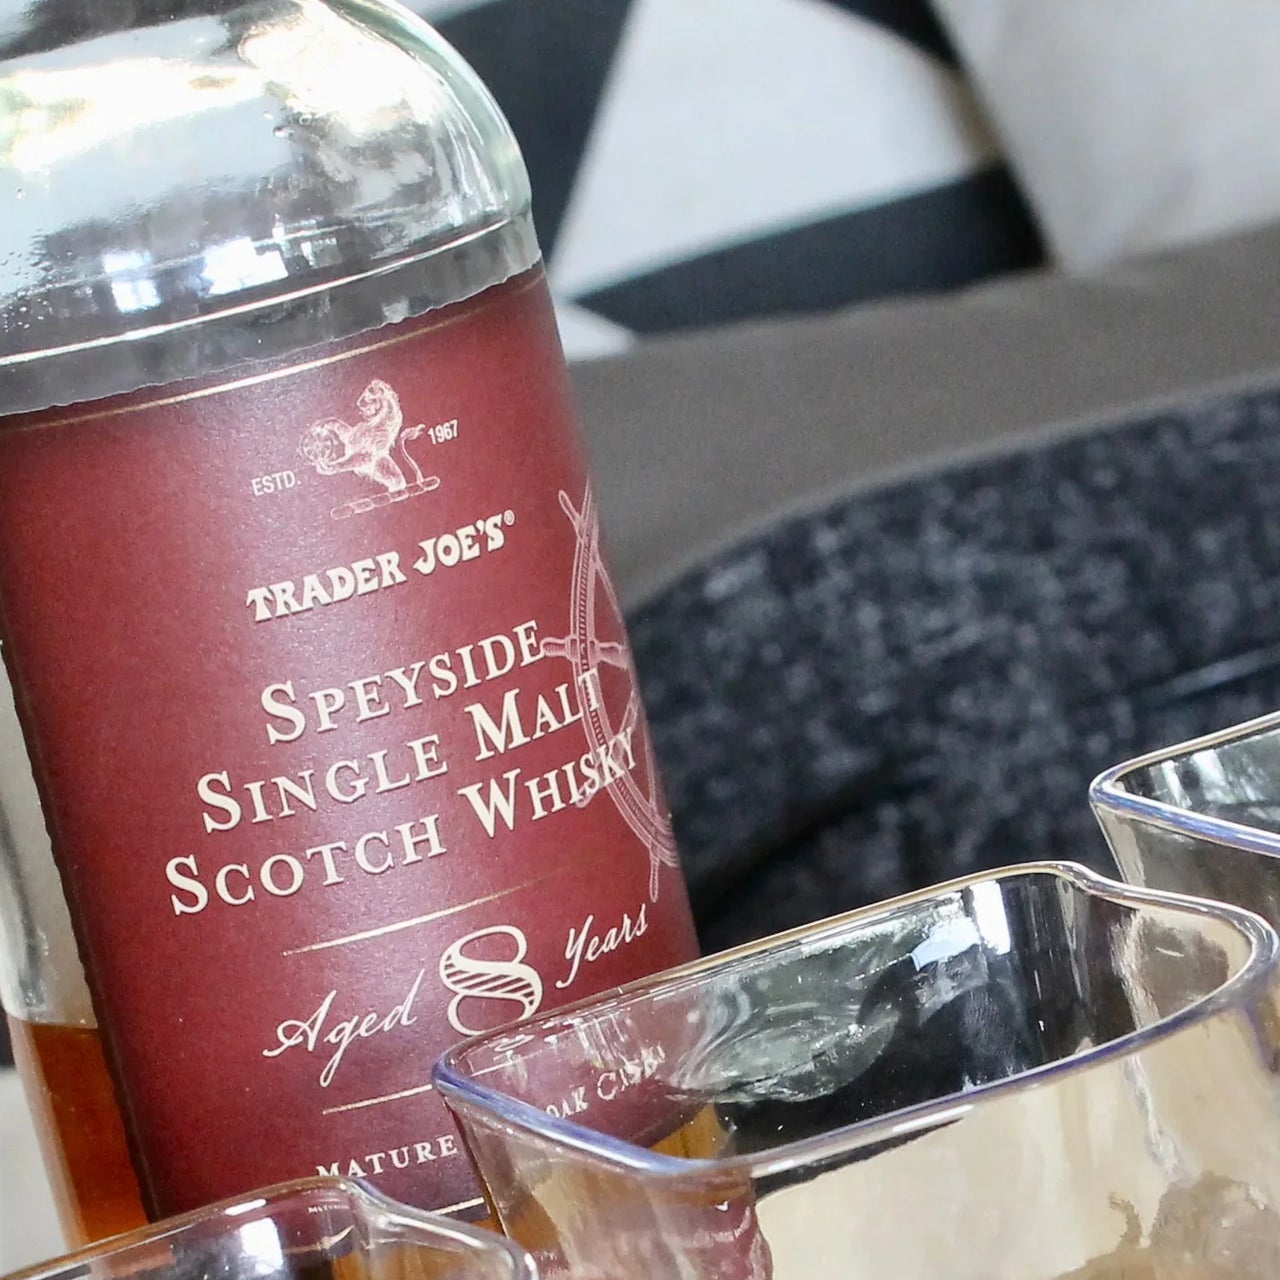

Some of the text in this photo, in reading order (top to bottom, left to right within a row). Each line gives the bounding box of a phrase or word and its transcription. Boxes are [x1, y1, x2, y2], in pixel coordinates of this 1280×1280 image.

[251, 418, 459, 497] ESTD. 1967
[245, 551, 407, 623] TRADER
[196, 669, 603, 834] SINGLE MALT
[260, 620, 547, 745] SPEYSIDE
[165, 725, 639, 915] SCOTCH WHISKY
[262, 903, 648, 1088] Aged 8 Years
